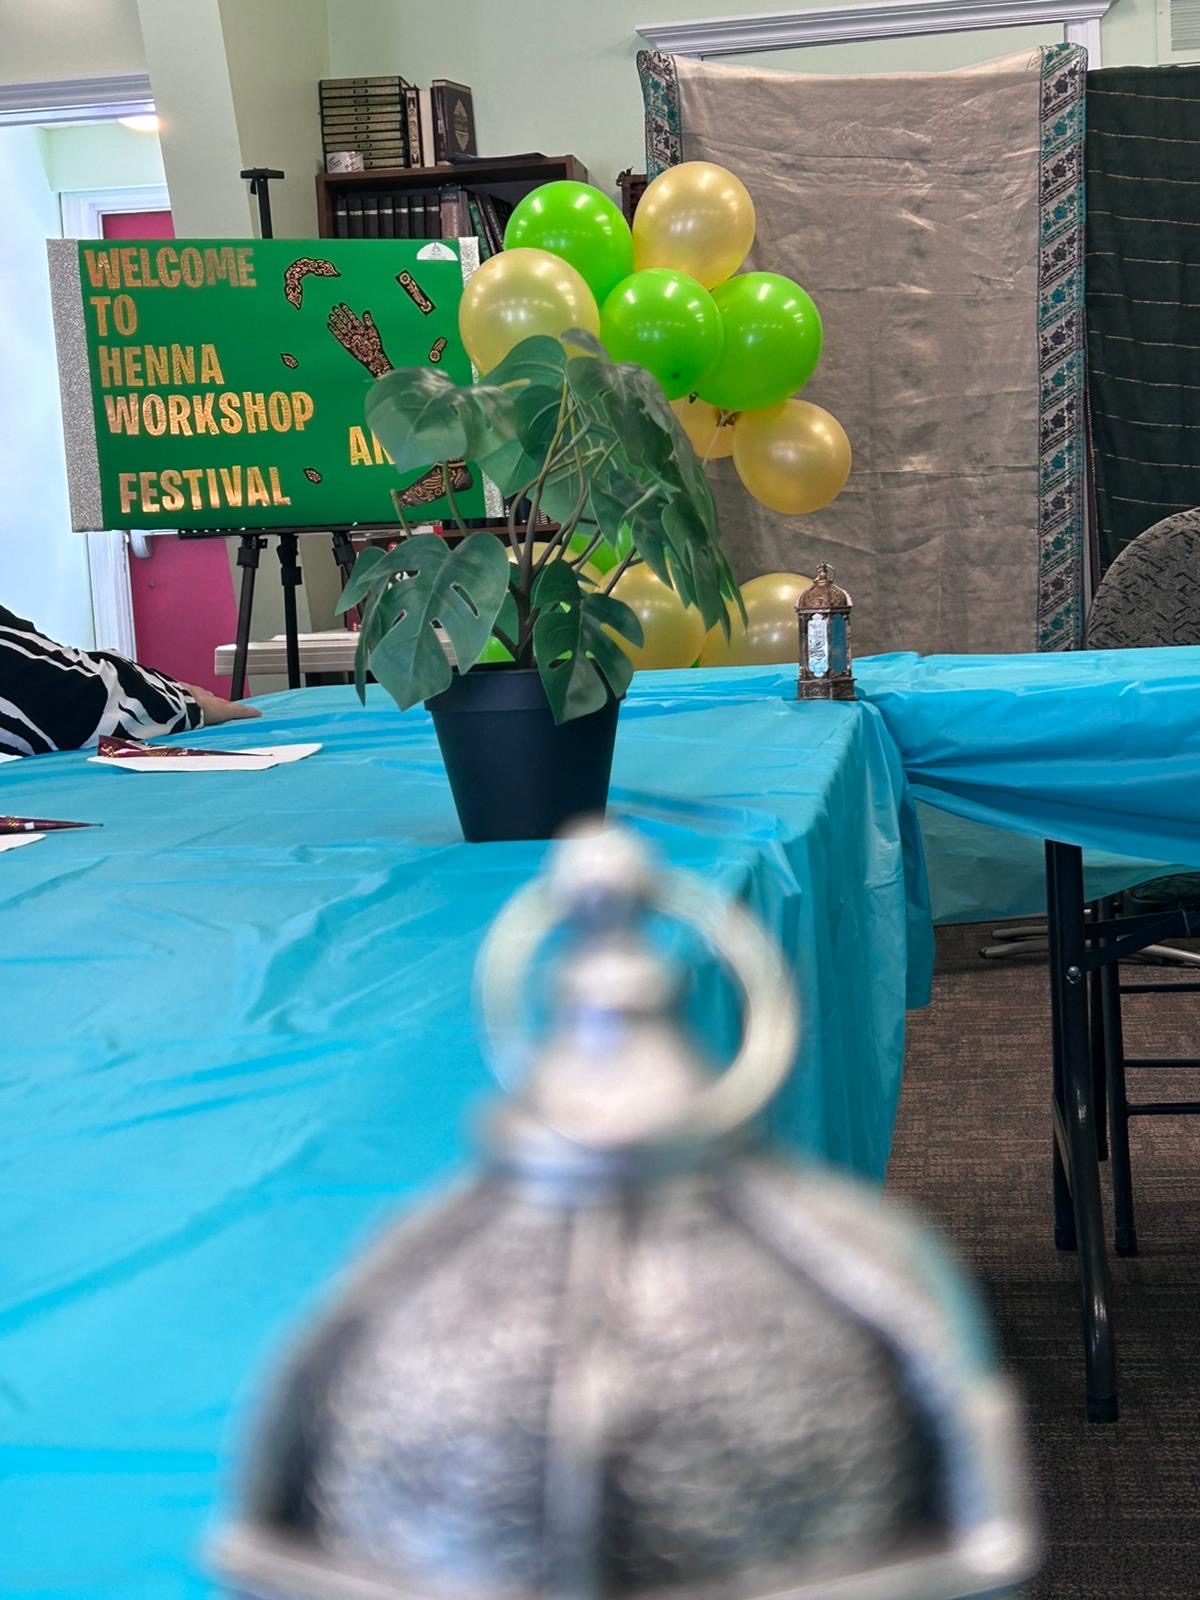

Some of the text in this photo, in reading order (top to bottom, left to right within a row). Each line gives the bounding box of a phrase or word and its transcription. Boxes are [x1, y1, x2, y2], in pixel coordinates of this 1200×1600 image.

[84, 246, 257, 289] WELCOME
[90, 294, 137, 336] TO
[98, 343, 225, 387] HENNA
[103, 391, 314, 436] WORKSHOP
[118, 465, 291, 514] FESTIVAL
